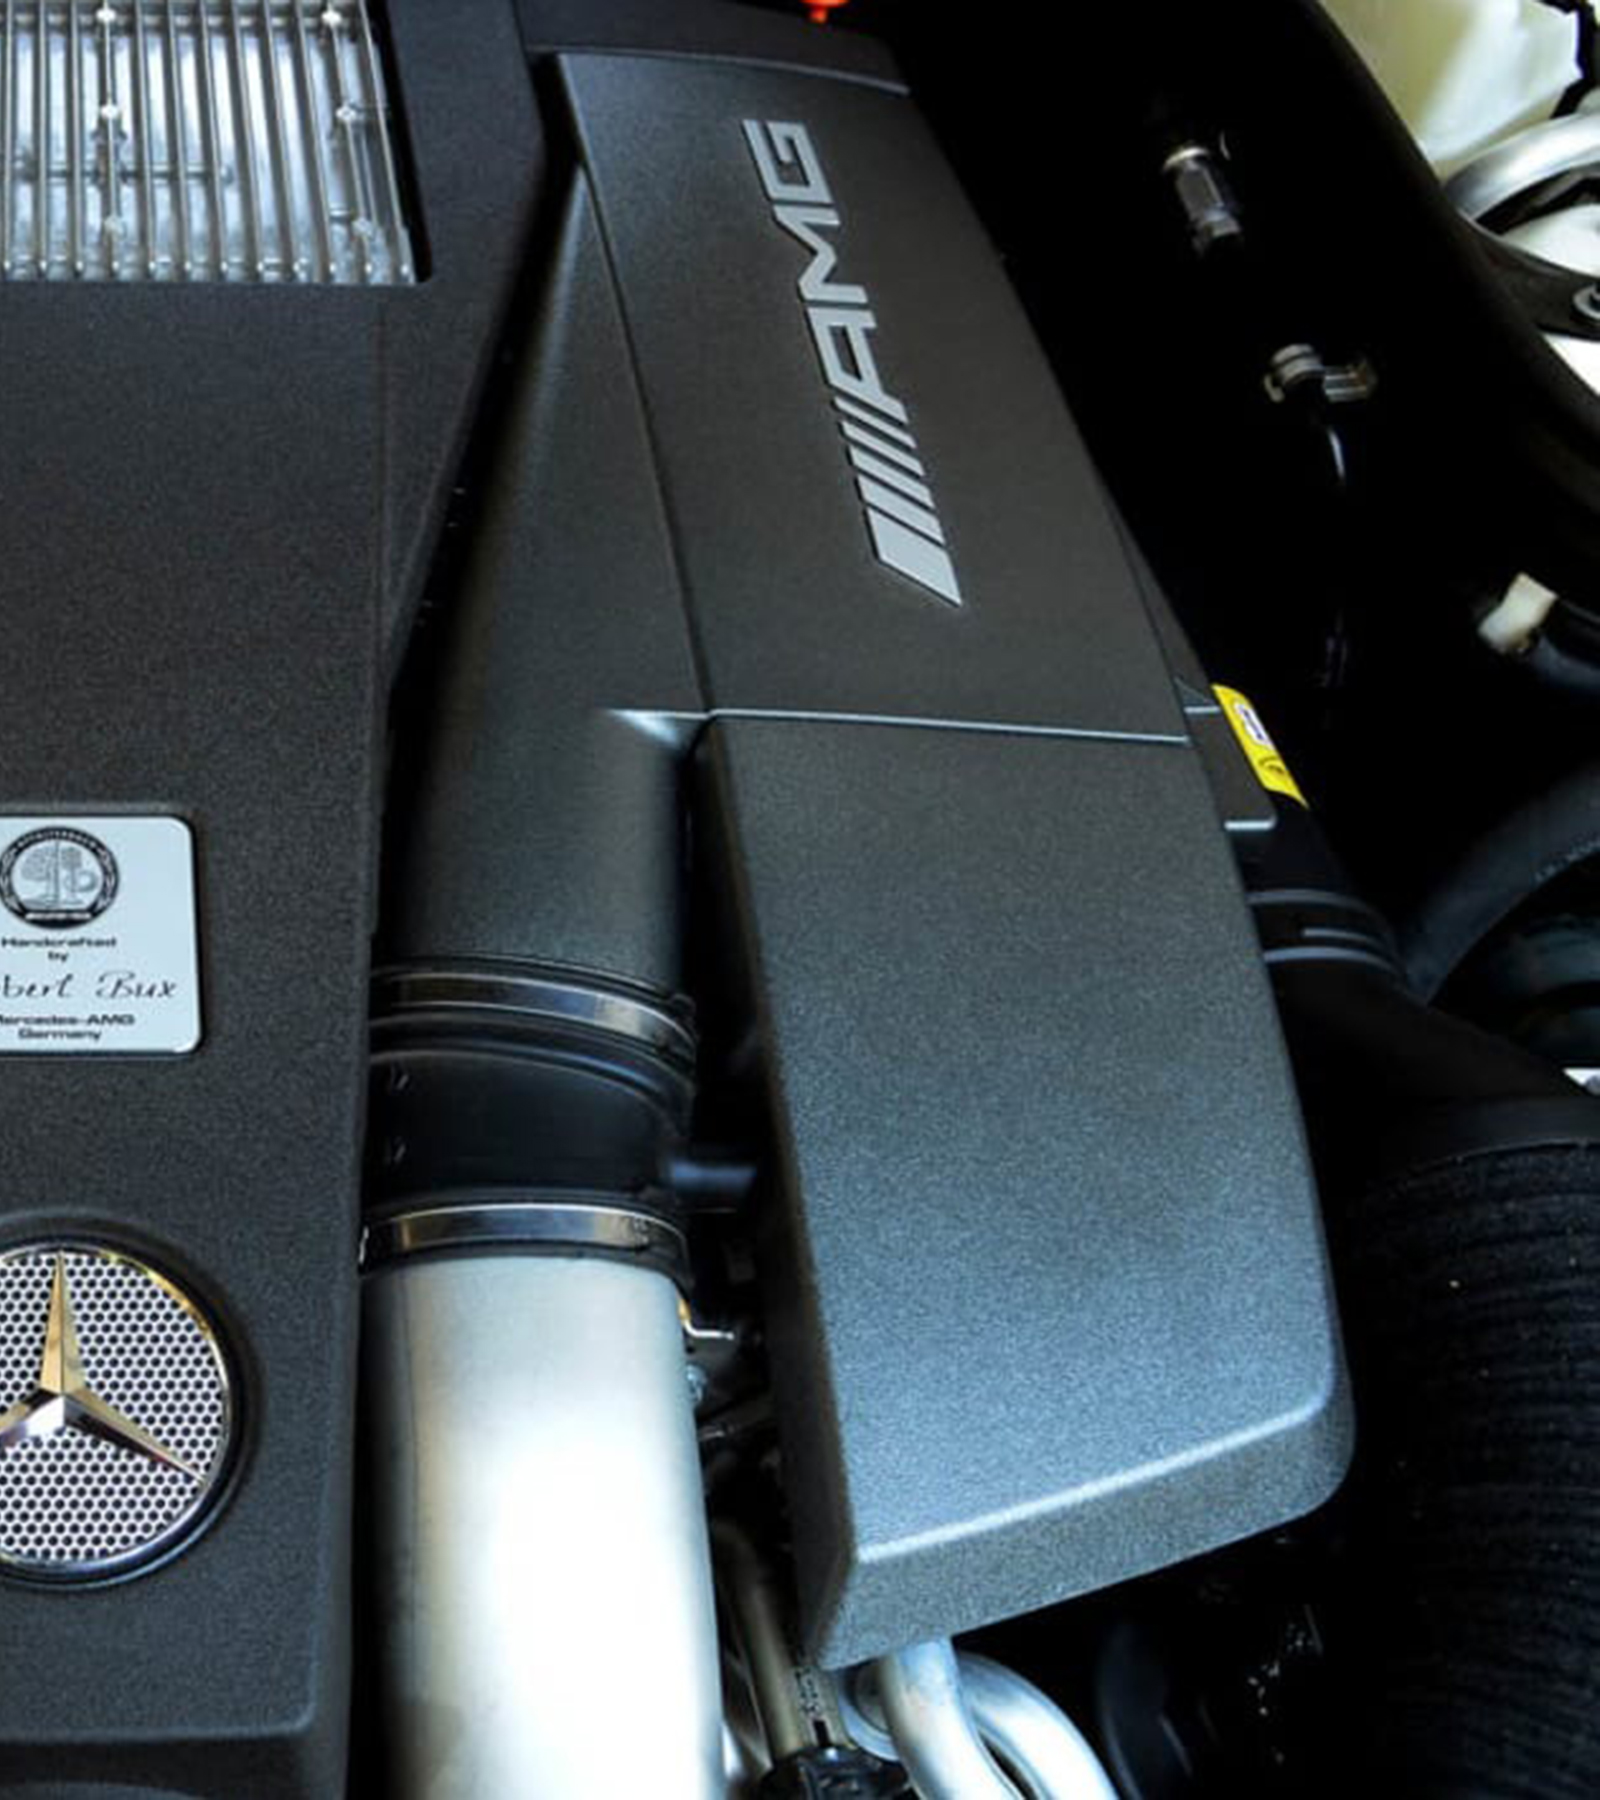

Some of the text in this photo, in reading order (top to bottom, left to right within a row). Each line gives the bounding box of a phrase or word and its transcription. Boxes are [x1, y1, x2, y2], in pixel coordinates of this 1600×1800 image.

[742, 118, 908, 425] AMG
[0, 937, 116, 948] Handcrafted
[48, 950, 68, 962] by
[96, 970, 176, 998] Bux
[18, 1029, 101, 1041] Germany
